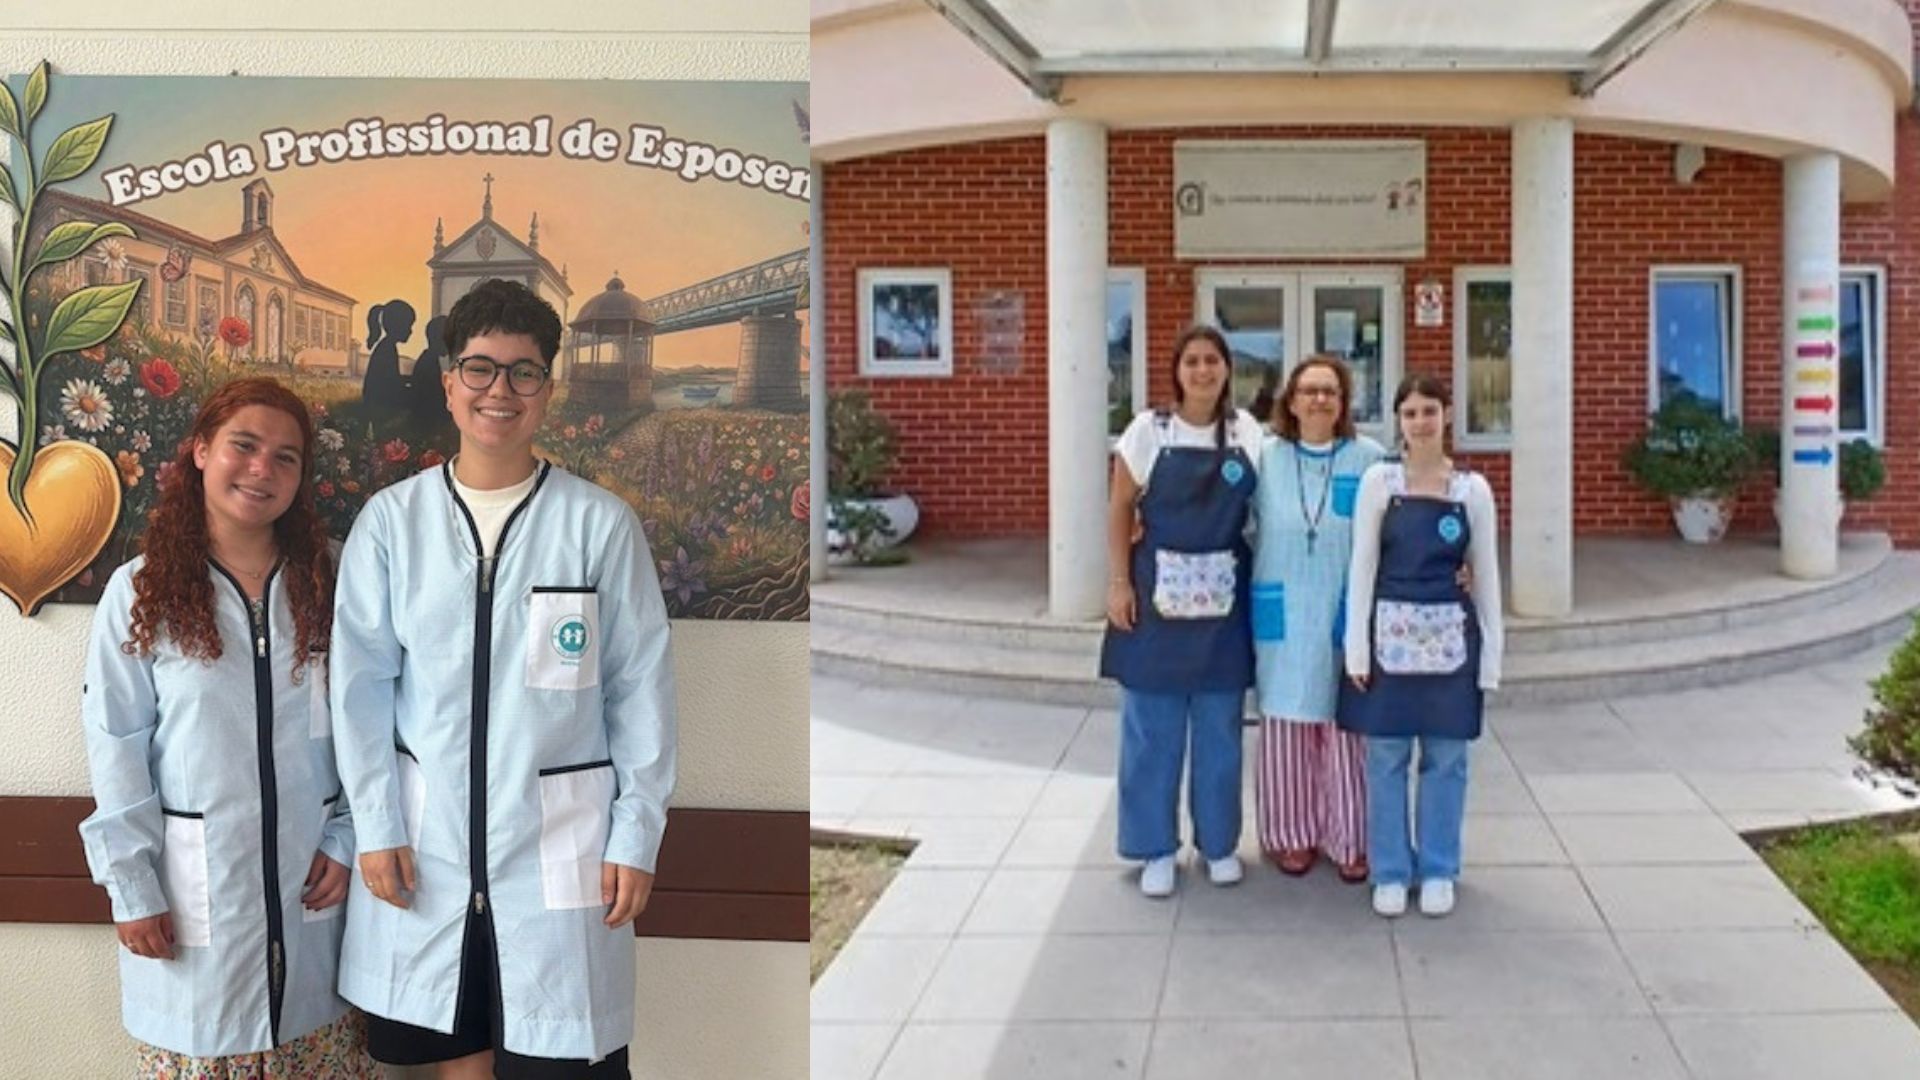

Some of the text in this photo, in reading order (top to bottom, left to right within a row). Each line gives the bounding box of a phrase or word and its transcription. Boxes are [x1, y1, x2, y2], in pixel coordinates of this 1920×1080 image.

[104, 143, 255, 206] Escola
[262, 116, 551, 170] Profissional
[560, 121, 619, 160] de
